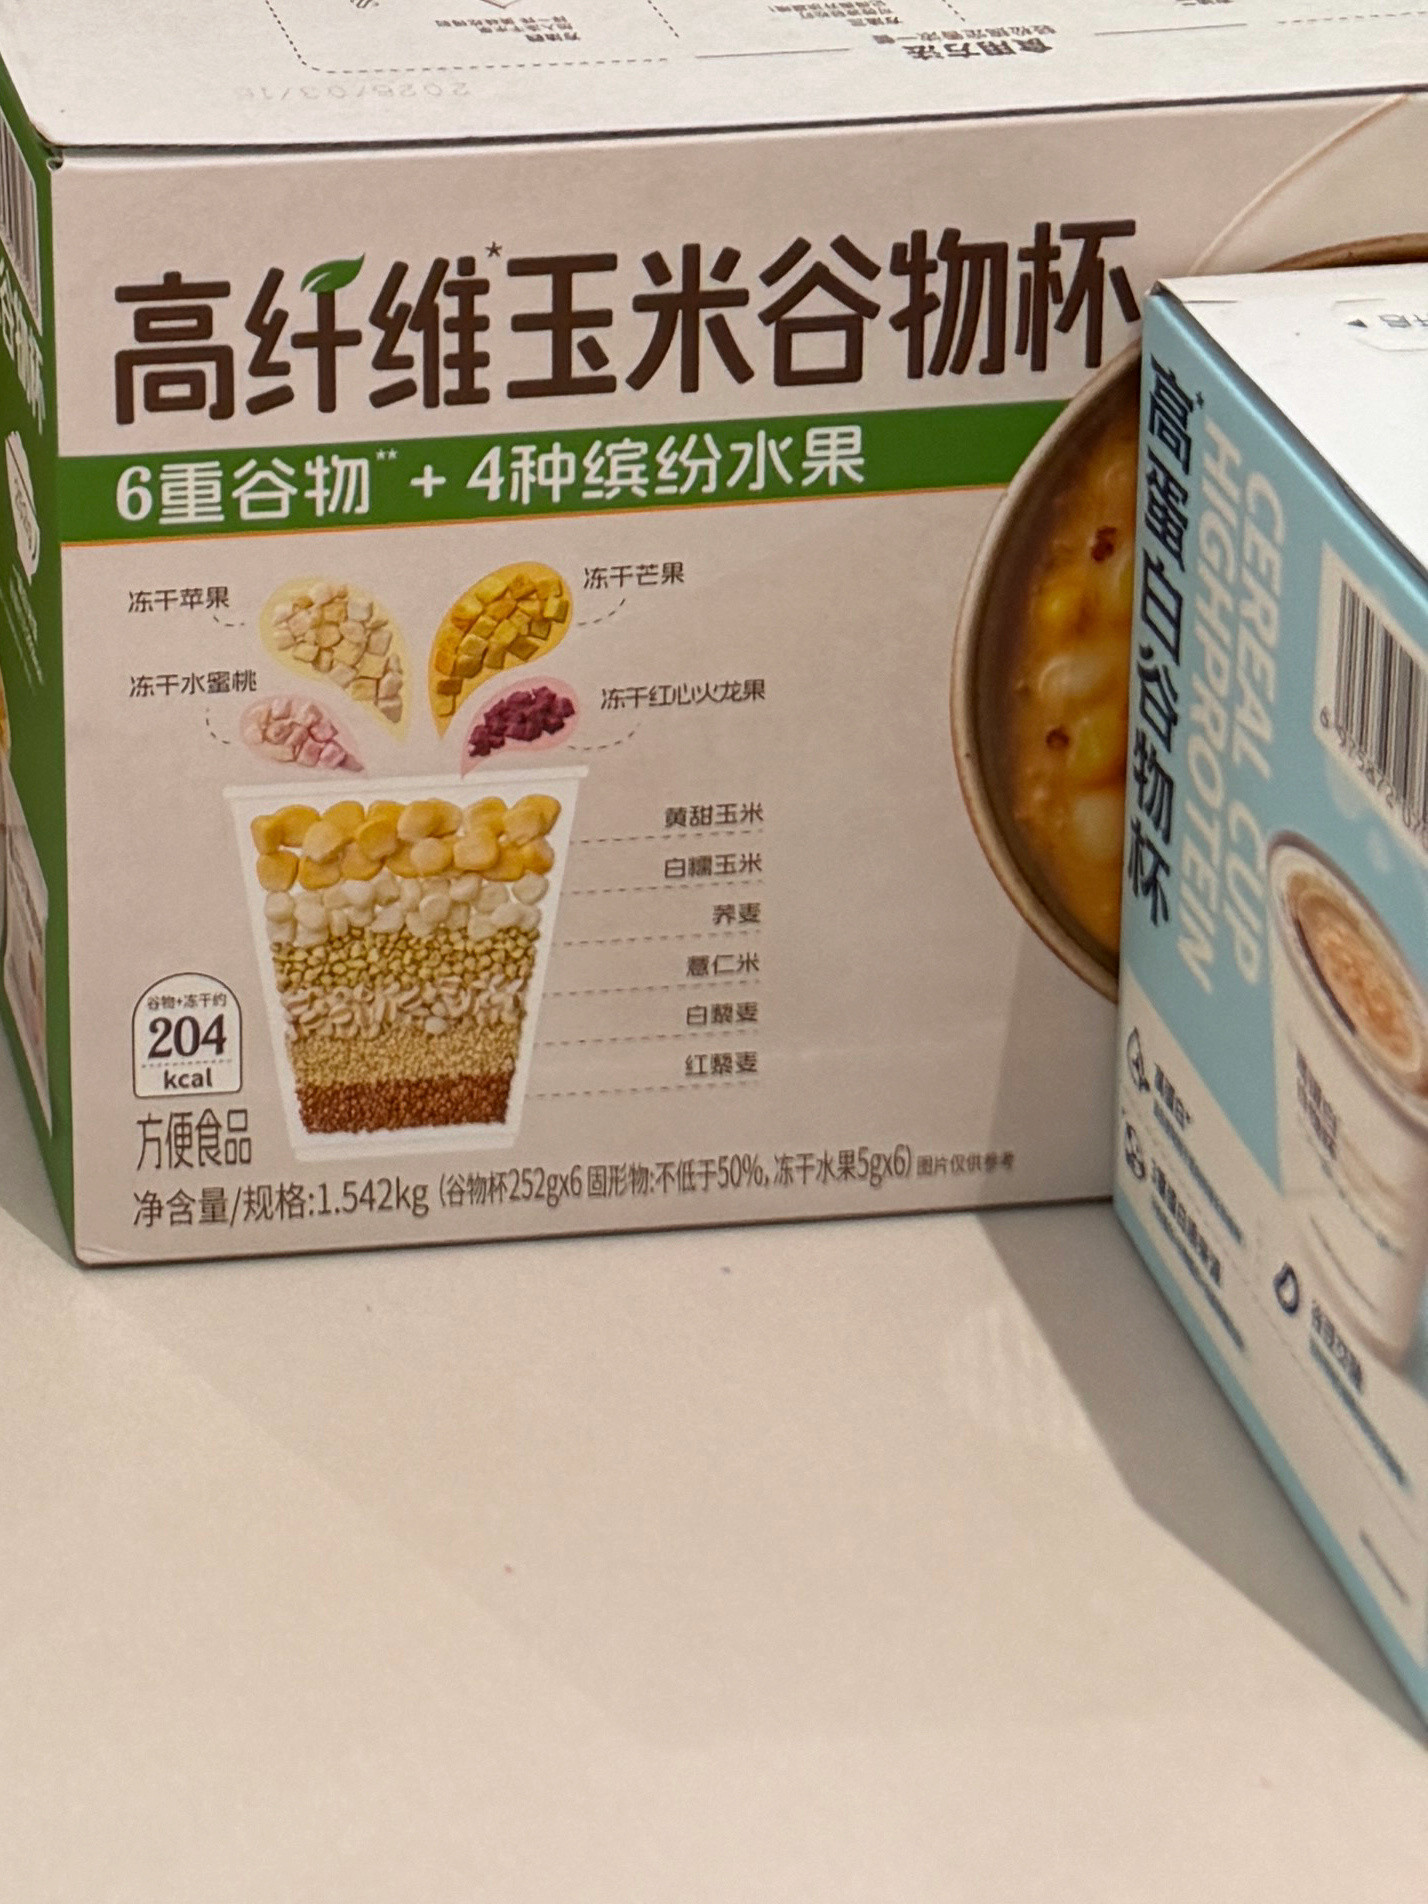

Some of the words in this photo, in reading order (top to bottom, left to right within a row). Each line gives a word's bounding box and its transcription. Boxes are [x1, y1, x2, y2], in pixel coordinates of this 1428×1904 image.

[901, 38, 1053, 61] 食用方法
[583, 561, 685, 589] 冻干芒果
[127, 586, 230, 614] 冻干苹果
[1231, 471, 1286, 779] CEREAL
[128, 669, 258, 699] 冻干水蜜桃
[599, 678, 766, 711] 冻干红心火龙果
[664, 802, 764, 829] 黄甜玉米
[664, 852, 763, 879] 白糯玉米
[1222, 800, 1266, 986] CUP
[712, 902, 761, 927] 荞麦
[685, 952, 760, 979] 薏仁米
[146, 992, 228, 1012] 谷物+冻干约
[685, 1002, 758, 1028] 白藜麦
[147, 1015, 228, 1061] 204
[684, 1051, 758, 1077] 红藜麦
[163, 1066, 213, 1091] kcal
[136, 1107, 252, 1171] 方便食品
